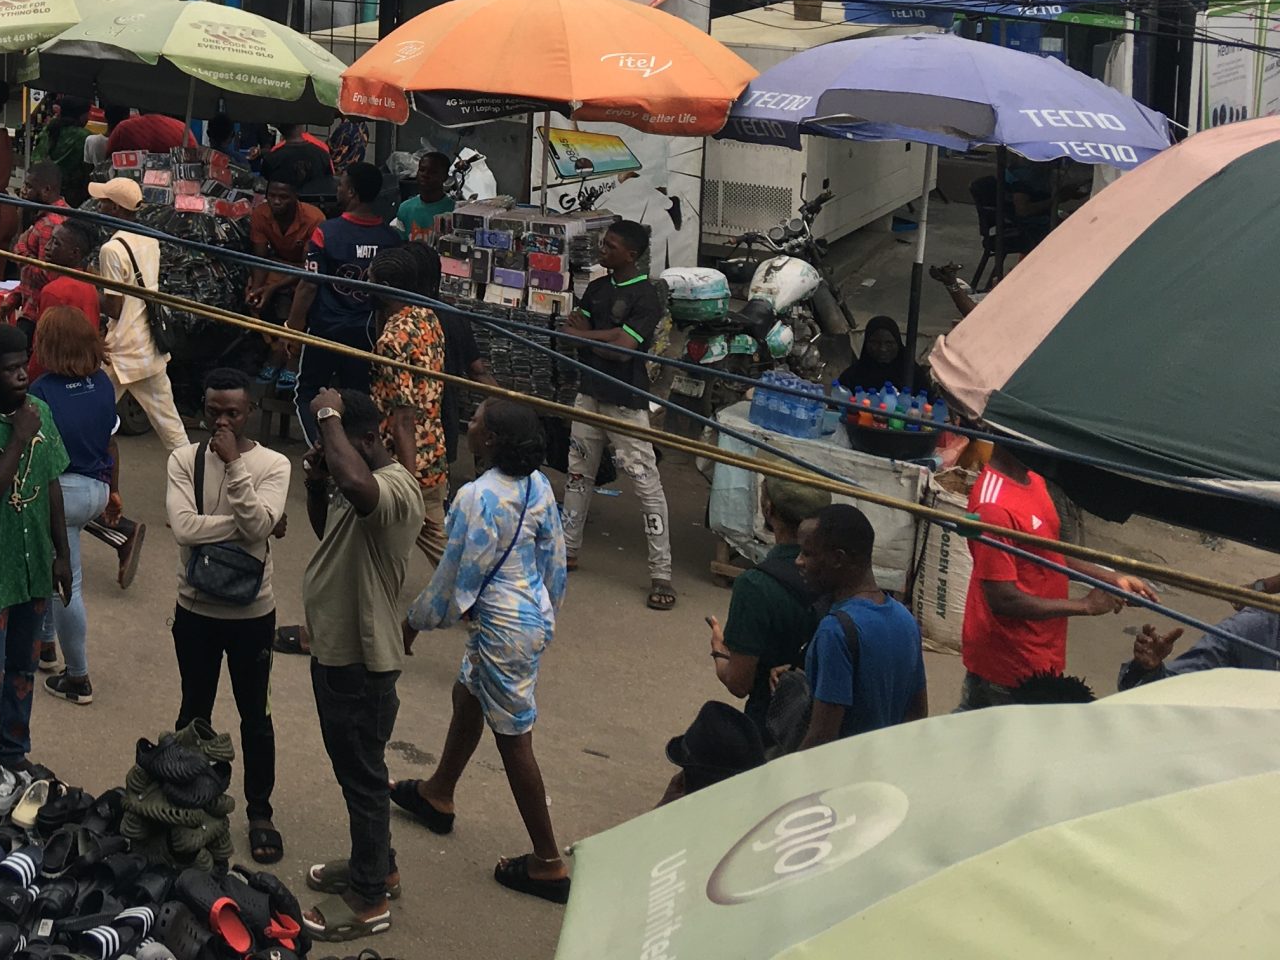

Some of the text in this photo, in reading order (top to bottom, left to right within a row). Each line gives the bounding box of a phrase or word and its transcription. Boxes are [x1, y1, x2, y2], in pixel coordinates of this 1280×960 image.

[1018, 3, 1062, 16] TECNO
[13, 33, 26, 43] 4G
[618, 54, 656, 70] itel
[235, 73, 249, 83] 4G
[250, 75, 291, 90] Network
[746, 90, 814, 112] TECNO
[461, 106, 471, 114] TV
[641, 112, 675, 124] Better
[677, 112, 697, 124] Life
[731, 118, 786, 139] TECNO
[1018, 108, 1128, 132] TECNO
[1049, 140, 1138, 164] TECNO
[355, 245, 379, 259] WATT
[936, 579, 947, 620] PENNY
[639, 848, 687, 960] Unlimite
